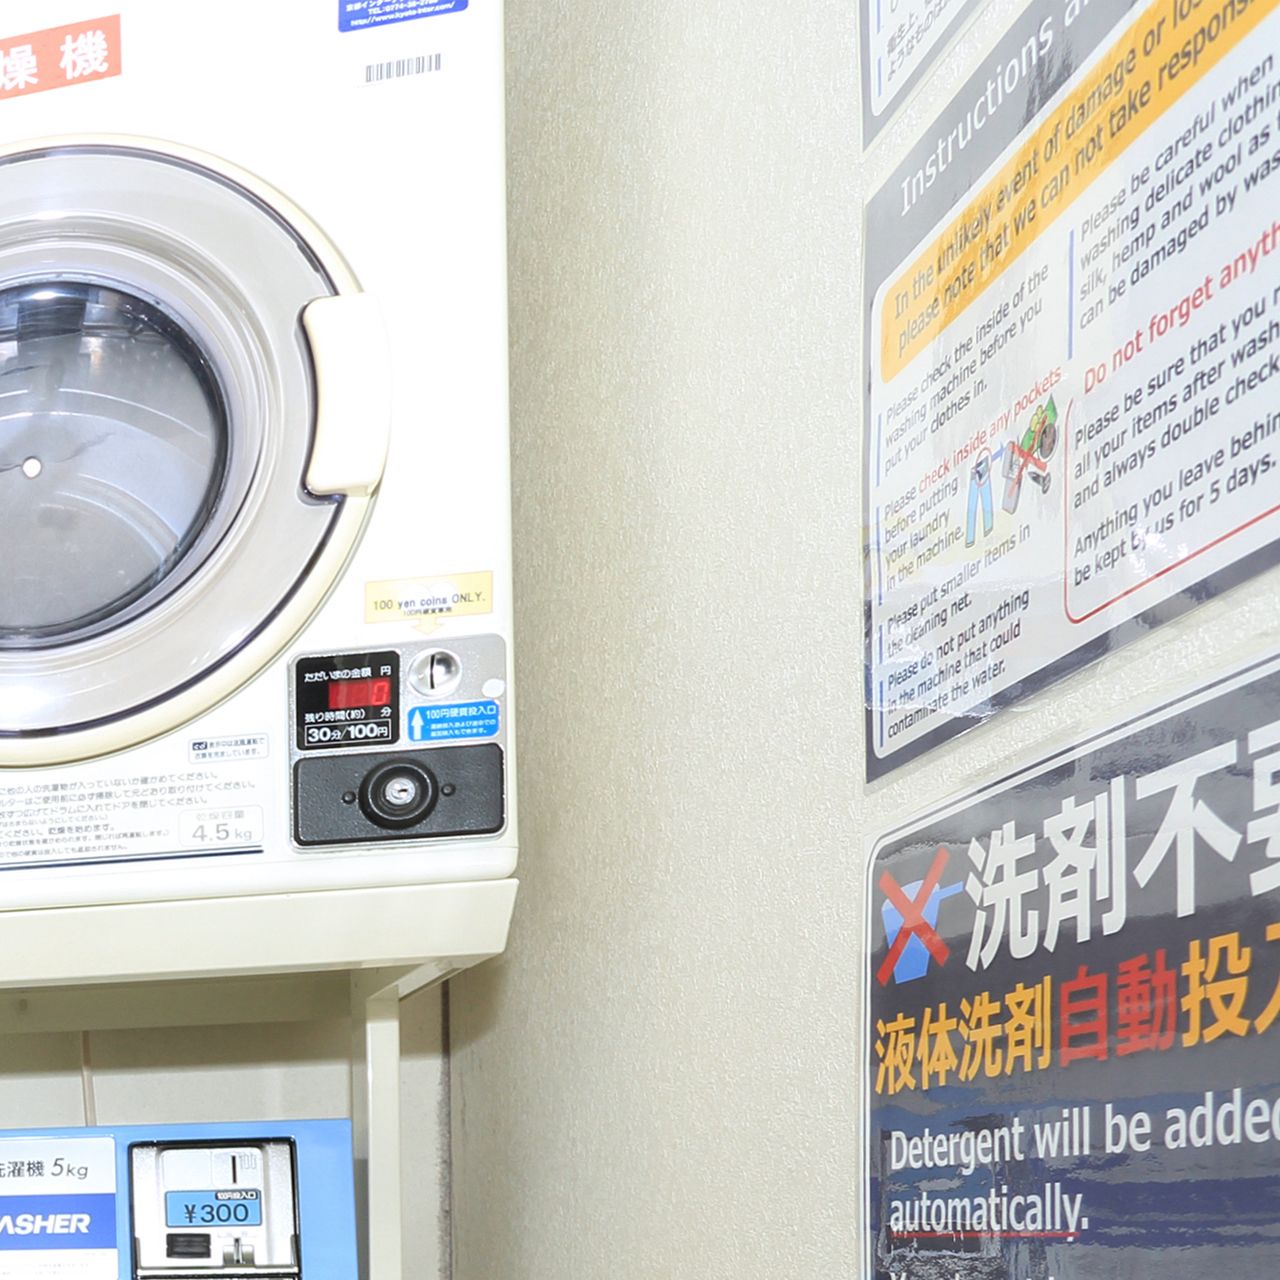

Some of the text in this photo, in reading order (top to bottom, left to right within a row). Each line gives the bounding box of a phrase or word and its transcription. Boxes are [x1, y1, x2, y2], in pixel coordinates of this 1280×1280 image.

[901, 16, 1053, 216] Instructions
[1081, 54, 1273, 242] Please careful when
[899, 80, 1151, 359] please note that can not take
[912, 264, 934, 301] the
[937, 203, 992, 275] unlikely
[996, 149, 1038, 213] event
[1066, 48, 1136, 140] damage
[1080, 142, 1212, 270] washing delicate
[1112, 125, 1270, 272] hemp and wool as
[1080, 185, 1237, 329] can damaged by
[885, 323, 1016, 448] washing machine before
[886, 303, 1009, 425] Please check inside
[1074, 297, 1266, 450] Please be sure that you
[1084, 276, 1212, 395] Do not forget
[884, 366, 1061, 521] Please check inside pockets
[1073, 397, 1219, 509] and always double
[1094, 360, 1225, 468] your items after
[885, 476, 959, 543] before putting
[910, 509, 950, 549] laundry
[1074, 449, 1224, 558] Anything you leave
[1095, 453, 1276, 574] kept for days.
[373, 591, 486, 611] 100 yen coins ONLY.
[940, 534, 1016, 598] smaller items
[304, 665, 392, 682] ただいまの金額 円
[887, 590, 1030, 691] Please anything
[917, 618, 1021, 698] machine could
[380, 706, 392, 718] 分
[191, 823, 254, 843] 4.5 kg
[51, 1157, 89, 1182] 5kg
[891, 1117, 1025, 1176] Detergent
[1034, 1106, 1091, 1158] will
[1105, 1103, 1152, 1154] be
[184, 1203, 249, 1224] ¥300
[890, 1182, 1089, 1241] automatically.
